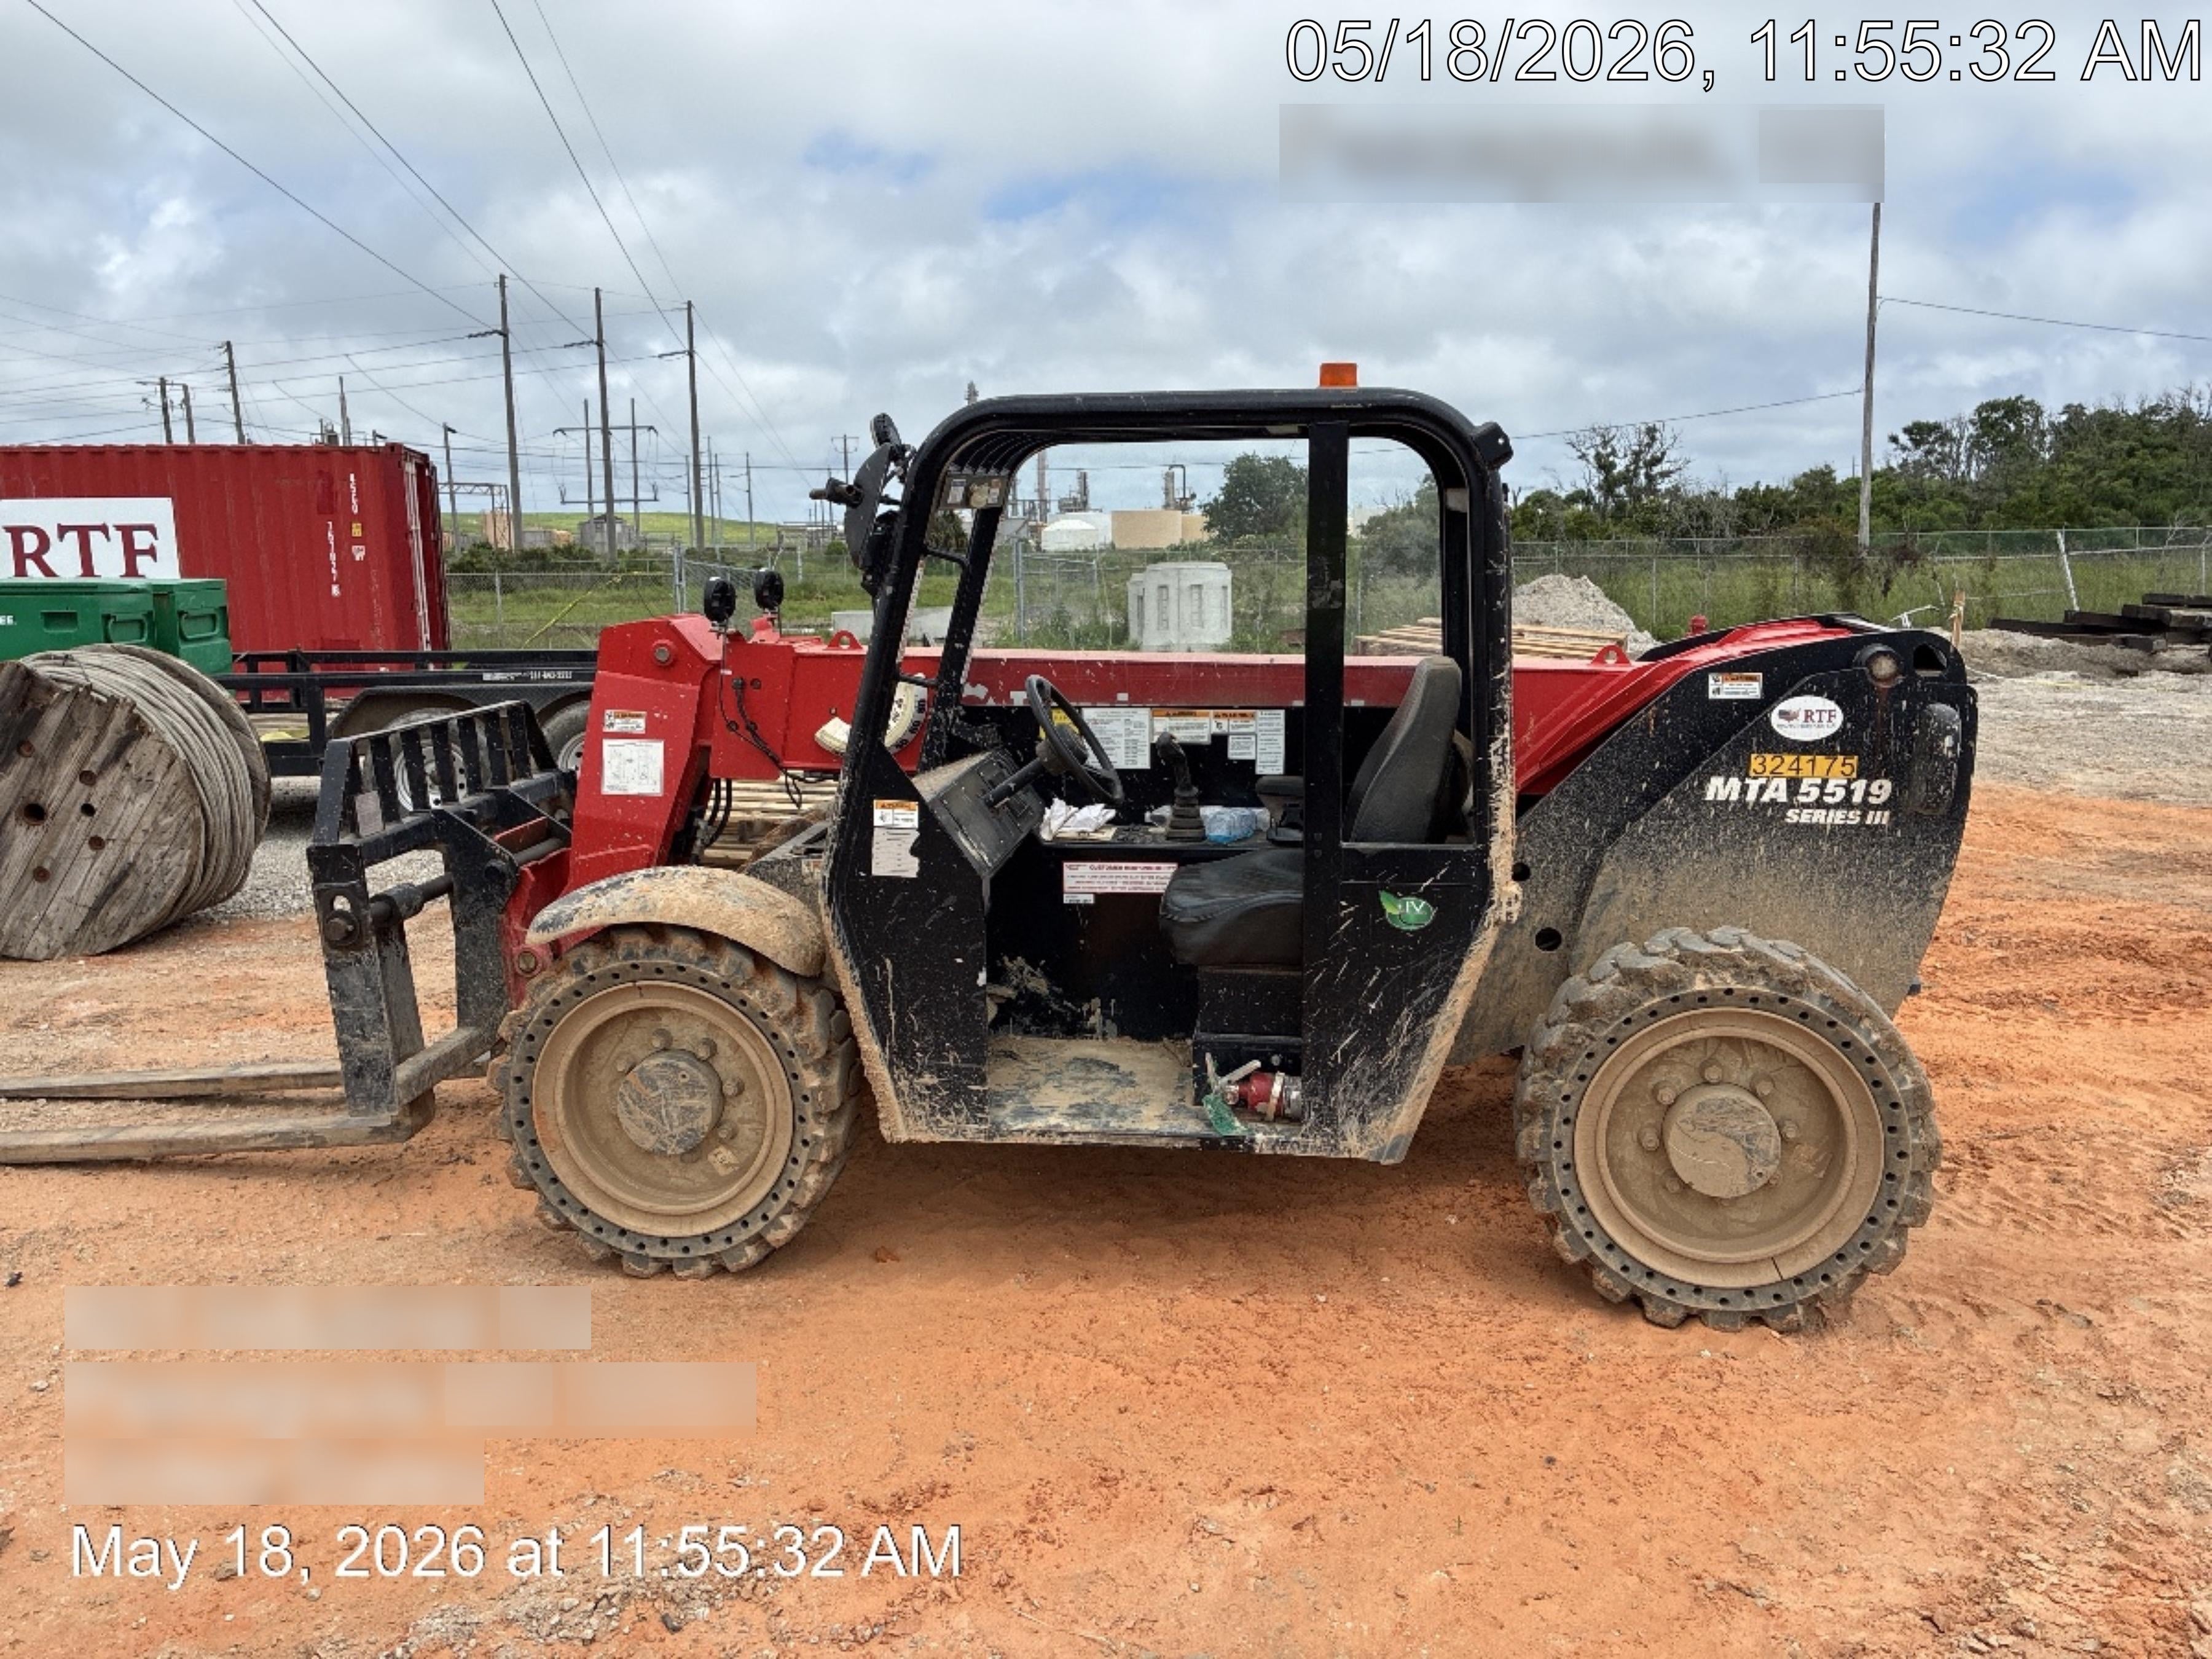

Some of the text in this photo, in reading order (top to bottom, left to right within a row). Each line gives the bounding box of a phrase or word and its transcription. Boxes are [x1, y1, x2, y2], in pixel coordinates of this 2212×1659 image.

[2, 522, 159, 578] RTF
[1803, 708, 1837, 723] RTF
[1752, 755, 1856, 776] 324175
[1704, 776, 1892, 804] MTA 5519
[1784, 808, 1891, 825] SERIES III
